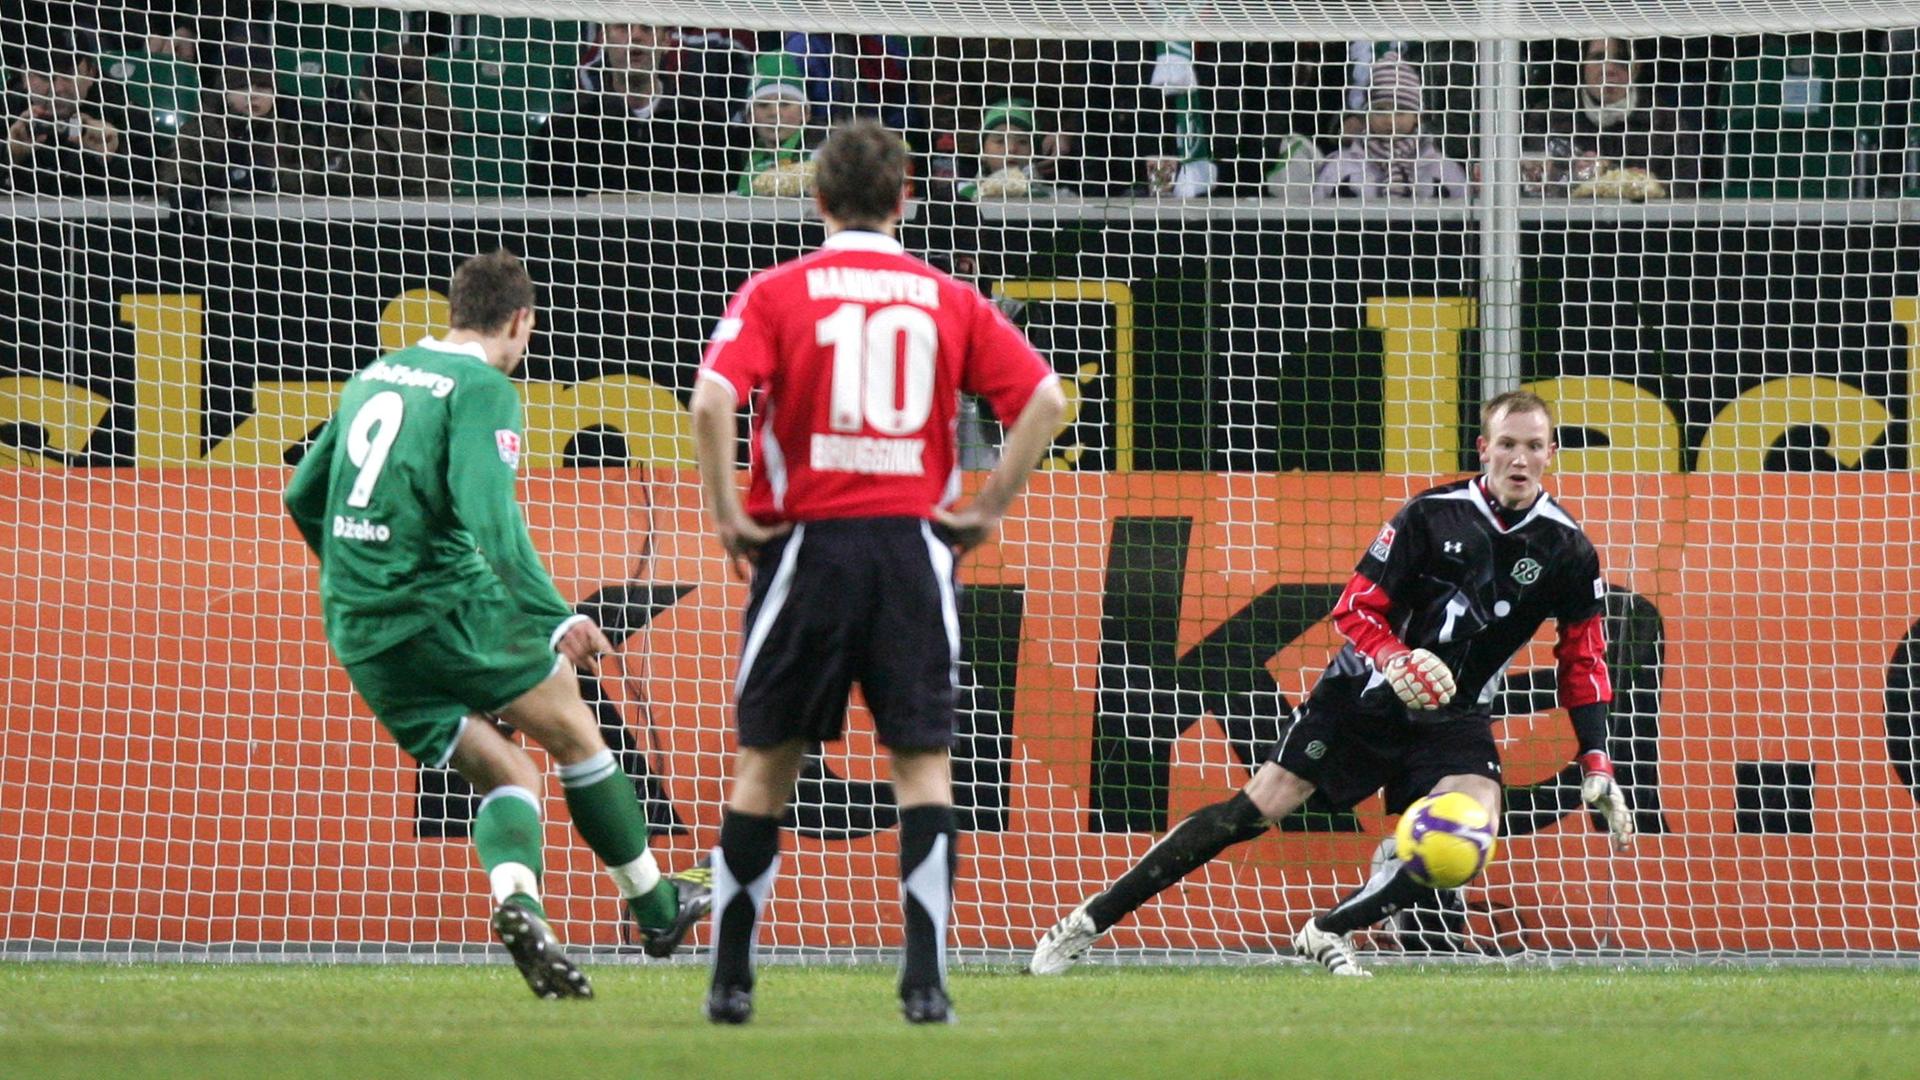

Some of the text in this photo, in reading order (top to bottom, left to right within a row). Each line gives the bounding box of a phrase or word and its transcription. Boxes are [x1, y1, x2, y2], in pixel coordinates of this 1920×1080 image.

[806, 267, 940, 310] HANNOVER
[815, 302, 939, 435] 10
[347, 391, 404, 508] 9
[810, 432, 925, 477] BRUGGINK
[332, 514, 390, 542] Džeko
[1512, 560, 1541, 582] 96
